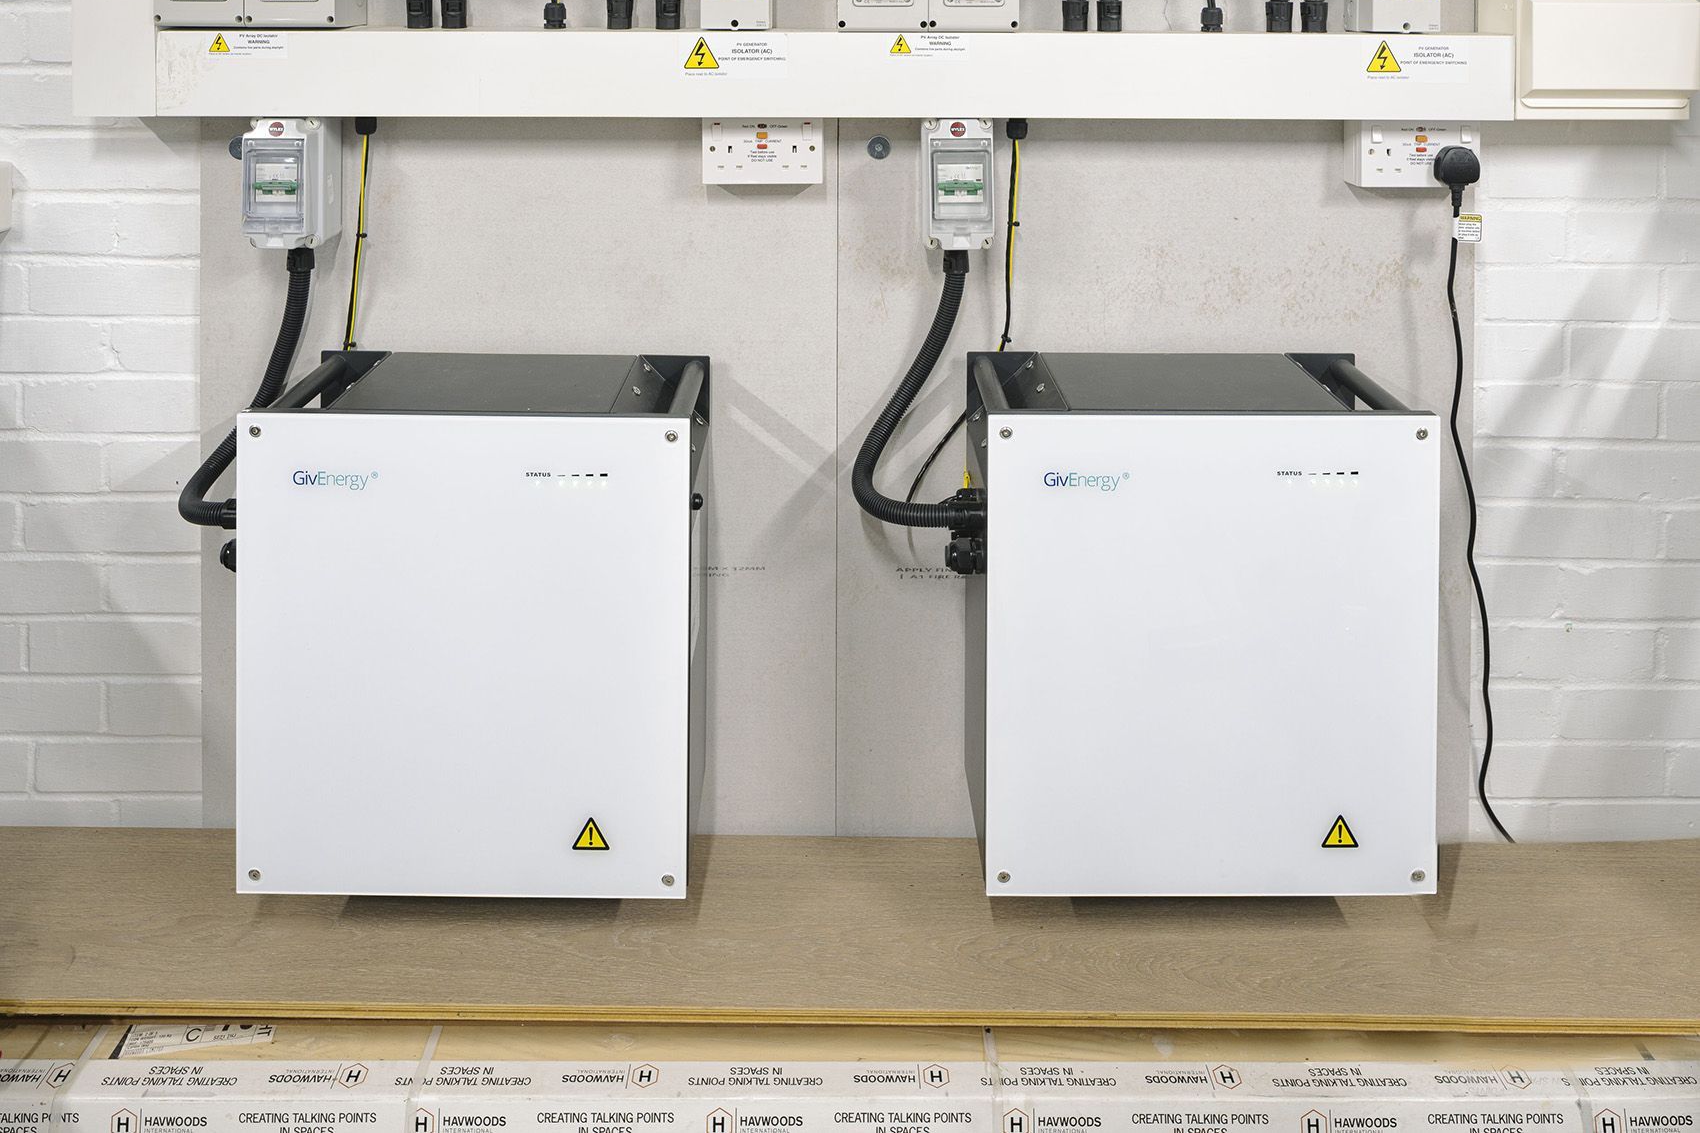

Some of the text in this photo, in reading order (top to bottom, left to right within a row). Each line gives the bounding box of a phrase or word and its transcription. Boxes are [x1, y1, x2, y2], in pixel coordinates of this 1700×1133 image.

[293, 471, 368, 490] GivEnergy
[1044, 472, 1120, 491] GivEnergy
[186, 1028, 202, 1042] C
[149, 1066, 204, 1075] IN SPACES
[440, 1066, 494, 1075] IN SPACES
[730, 1067, 782, 1075] IN SPACES
[1020, 1067, 1073, 1076] IN SPACES
[1308, 1067, 1362, 1076] IN SPACES
[1595, 1066, 1649, 1076] IN SPACES
[0, 1074, 41, 1083] HAVWO
[54, 1070, 71, 1083] H
[101, 1077, 238, 1086] CREATING TALKING POINTS
[268, 1074, 333, 1083] HAVWOODS
[346, 1070, 361, 1083] H
[394, 1077, 531, 1086] CREATING TALKING PNTS
[562, 1074, 624, 1083] HAVWOODS
[639, 1070, 652, 1083] H
[688, 1077, 823, 1086] CREATING TALKING POINTS
[854, 1074, 916, 1083] HAVWOODS
[931, 1070, 942, 1083] H
[980, 1077, 1116, 1086] CREATING TALKING POITS
[1145, 1075, 1208, 1084] HAVWOODS
[1220, 1071, 1234, 1084] H
[1435, 1075, 1498, 1084] HAVWOODS
[1507, 1071, 1524, 1083] H
[1561, 1077, 1698, 1087] CREATING TALKING POIS
[1272, 1078, 1408, 1087] CREATING TALKING POINTS
[42, 1113, 79, 1123] PNTS
[145, 1117, 207, 1127] HAVWOODS
[239, 1113, 377, 1123] CREATING TALKING POINTS
[443, 1116, 506, 1127] HAVWOODS
[537, 1112, 674, 1123] CREATING TALKING POINTS
[740, 1116, 803, 1127] HAVWOODS
[834, 1112, 972, 1123] CREATING TALKING POINTS
[1038, 1116, 1101, 1127] HAVWOODS
[1132, 1114, 1268, 1124] CREATING TALKING POINTS
[1335, 1117, 1397, 1128] HAVWOODS
[1428, 1113, 1564, 1124] CREATING TALKING POINTS
[1630, 1115, 1693, 1127] HAVWOODS
[117, 1117, 129, 1132] H
[416, 1117, 427, 1132] H
[713, 1117, 724, 1132] H
[1010, 1117, 1022, 1133] H
[1307, 1118, 1319, 1133] H
[1602, 1117, 1614, 1133] H
